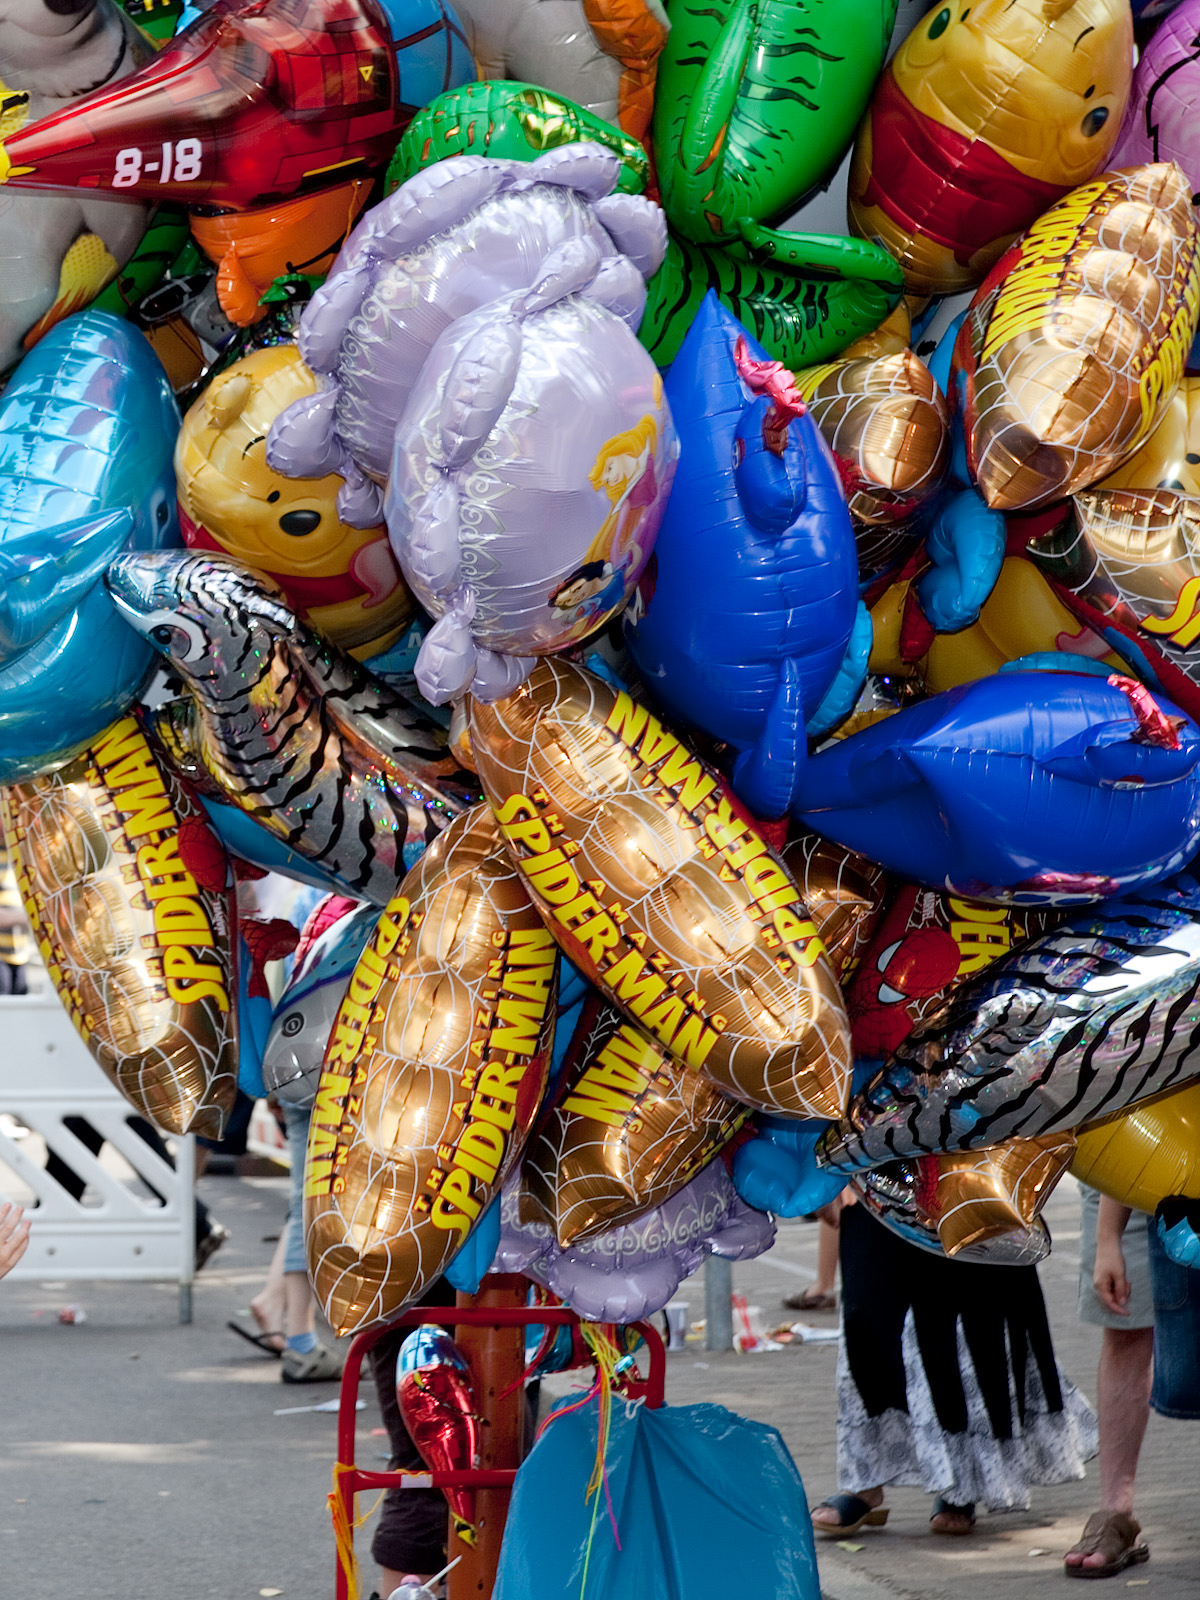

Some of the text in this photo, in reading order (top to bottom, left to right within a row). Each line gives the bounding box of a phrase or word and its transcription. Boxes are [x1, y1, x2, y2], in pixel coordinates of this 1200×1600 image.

[111, 137, 203, 188] 8-18
[1056, 225, 1099, 327] AMAZING
[90, 716, 231, 1014] SPIDER-MAN
[495, 792, 726, 1073] SPIDER-MAN
[533, 787, 581, 859] THE
[589, 878, 727, 1031] AMAZING
[605, 690, 833, 968] SPIDER-MAN
[743, 901, 794, 977] THE
[141, 932, 170, 1005] THE
[331, 911, 425, 1194] THE AMAZING
[413, 930, 508, 1214] THE AMAZING
[429, 926, 559, 1249] SPIDER-MAN
